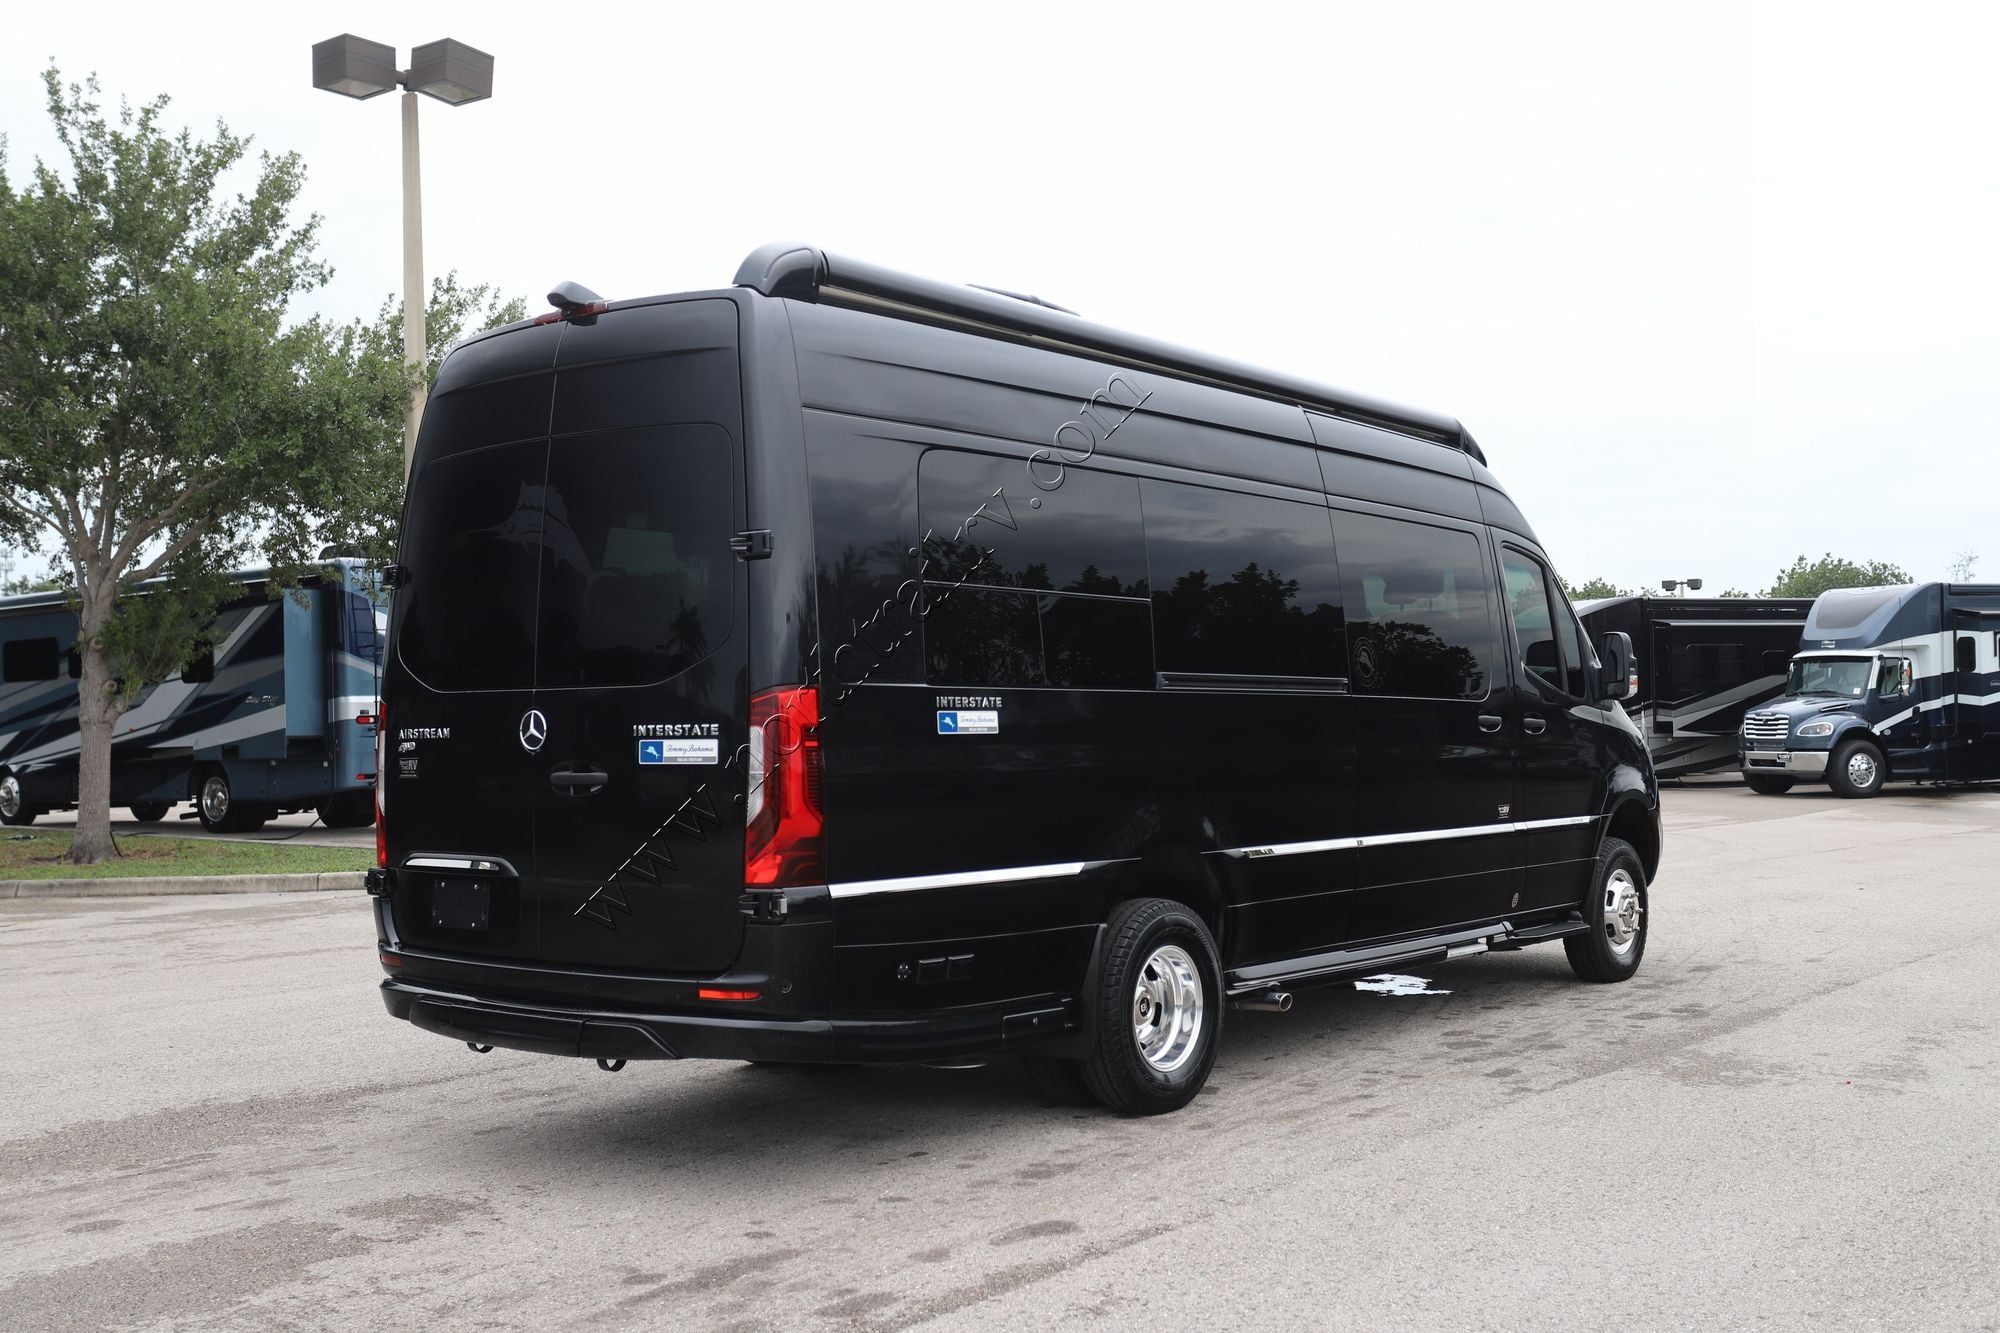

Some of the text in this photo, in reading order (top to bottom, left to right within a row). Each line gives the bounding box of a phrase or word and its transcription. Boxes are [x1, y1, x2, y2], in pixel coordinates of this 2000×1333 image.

[936, 696, 1002, 708] INTERSTATE
[398, 727, 450, 740] AIRSTREAM
[633, 723, 719, 737] INTERSTATE
[665, 744, 714, 754] Tommy Bahama
